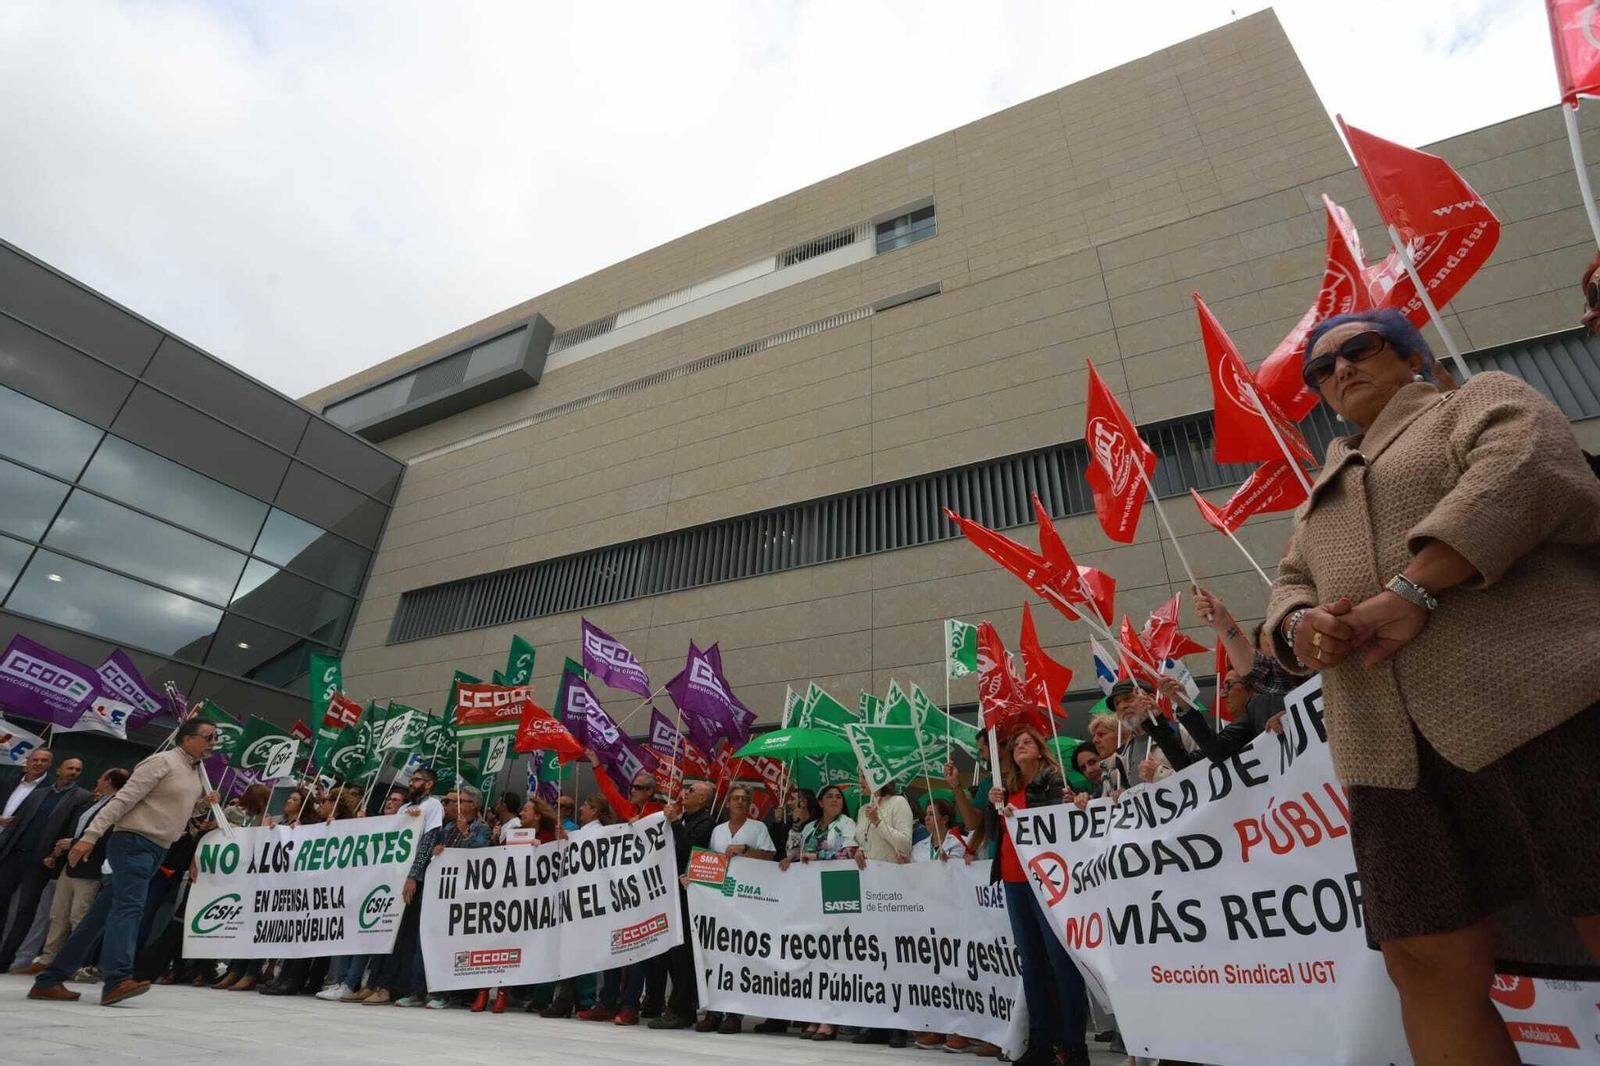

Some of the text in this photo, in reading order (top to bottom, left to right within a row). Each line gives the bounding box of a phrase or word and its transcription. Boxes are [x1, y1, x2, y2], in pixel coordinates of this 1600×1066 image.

[0, 674, 29, 689] ervicios
[1016, 812, 1058, 846] EN
[1068, 778, 1199, 843] DEFENSA
[1207, 744, 1269, 802] DE
[200, 843, 240, 875] NO
[258, 840, 294, 874] LOS
[294, 828, 414, 872] RECORTES
[1071, 782, 1351, 895] SANIDAD PÚBLI
[465, 858, 497, 890] NO
[502, 856, 518, 889] A
[525, 851, 562, 886] LOS
[560, 832, 644, 879] ECORTES
[700, 855, 719, 864] SMA
[253, 886, 346, 913] EN DEFENSA DE LA
[448, 895, 556, 936] PERSONAL
[558, 889, 573, 924] N
[577, 884, 606, 920] EL
[609, 874, 641, 913] SAS
[737, 884, 761, 895] SMA
[866, 891, 903, 900] Sindicato
[824, 900, 860, 912] SATSE
[866, 903, 876, 912] de
[1066, 911, 1103, 950] NO
[1107, 890, 1207, 946] MÁS
[253, 912, 345, 944] SANIDAD PÚBLICA
[780, 926, 887, 971] recortes,
[895, 927, 961, 975] mejor
[1151, 960, 1336, 985] Sección Sindical UGT
[717, 963, 734, 991] la
[739, 966, 813, 999] Sanidad
[819, 971, 886, 1004] Pública
[892, 982, 901, 1013] y
[908, 980, 985, 1014] nuestros
[989, 986, 1016, 1022] der
